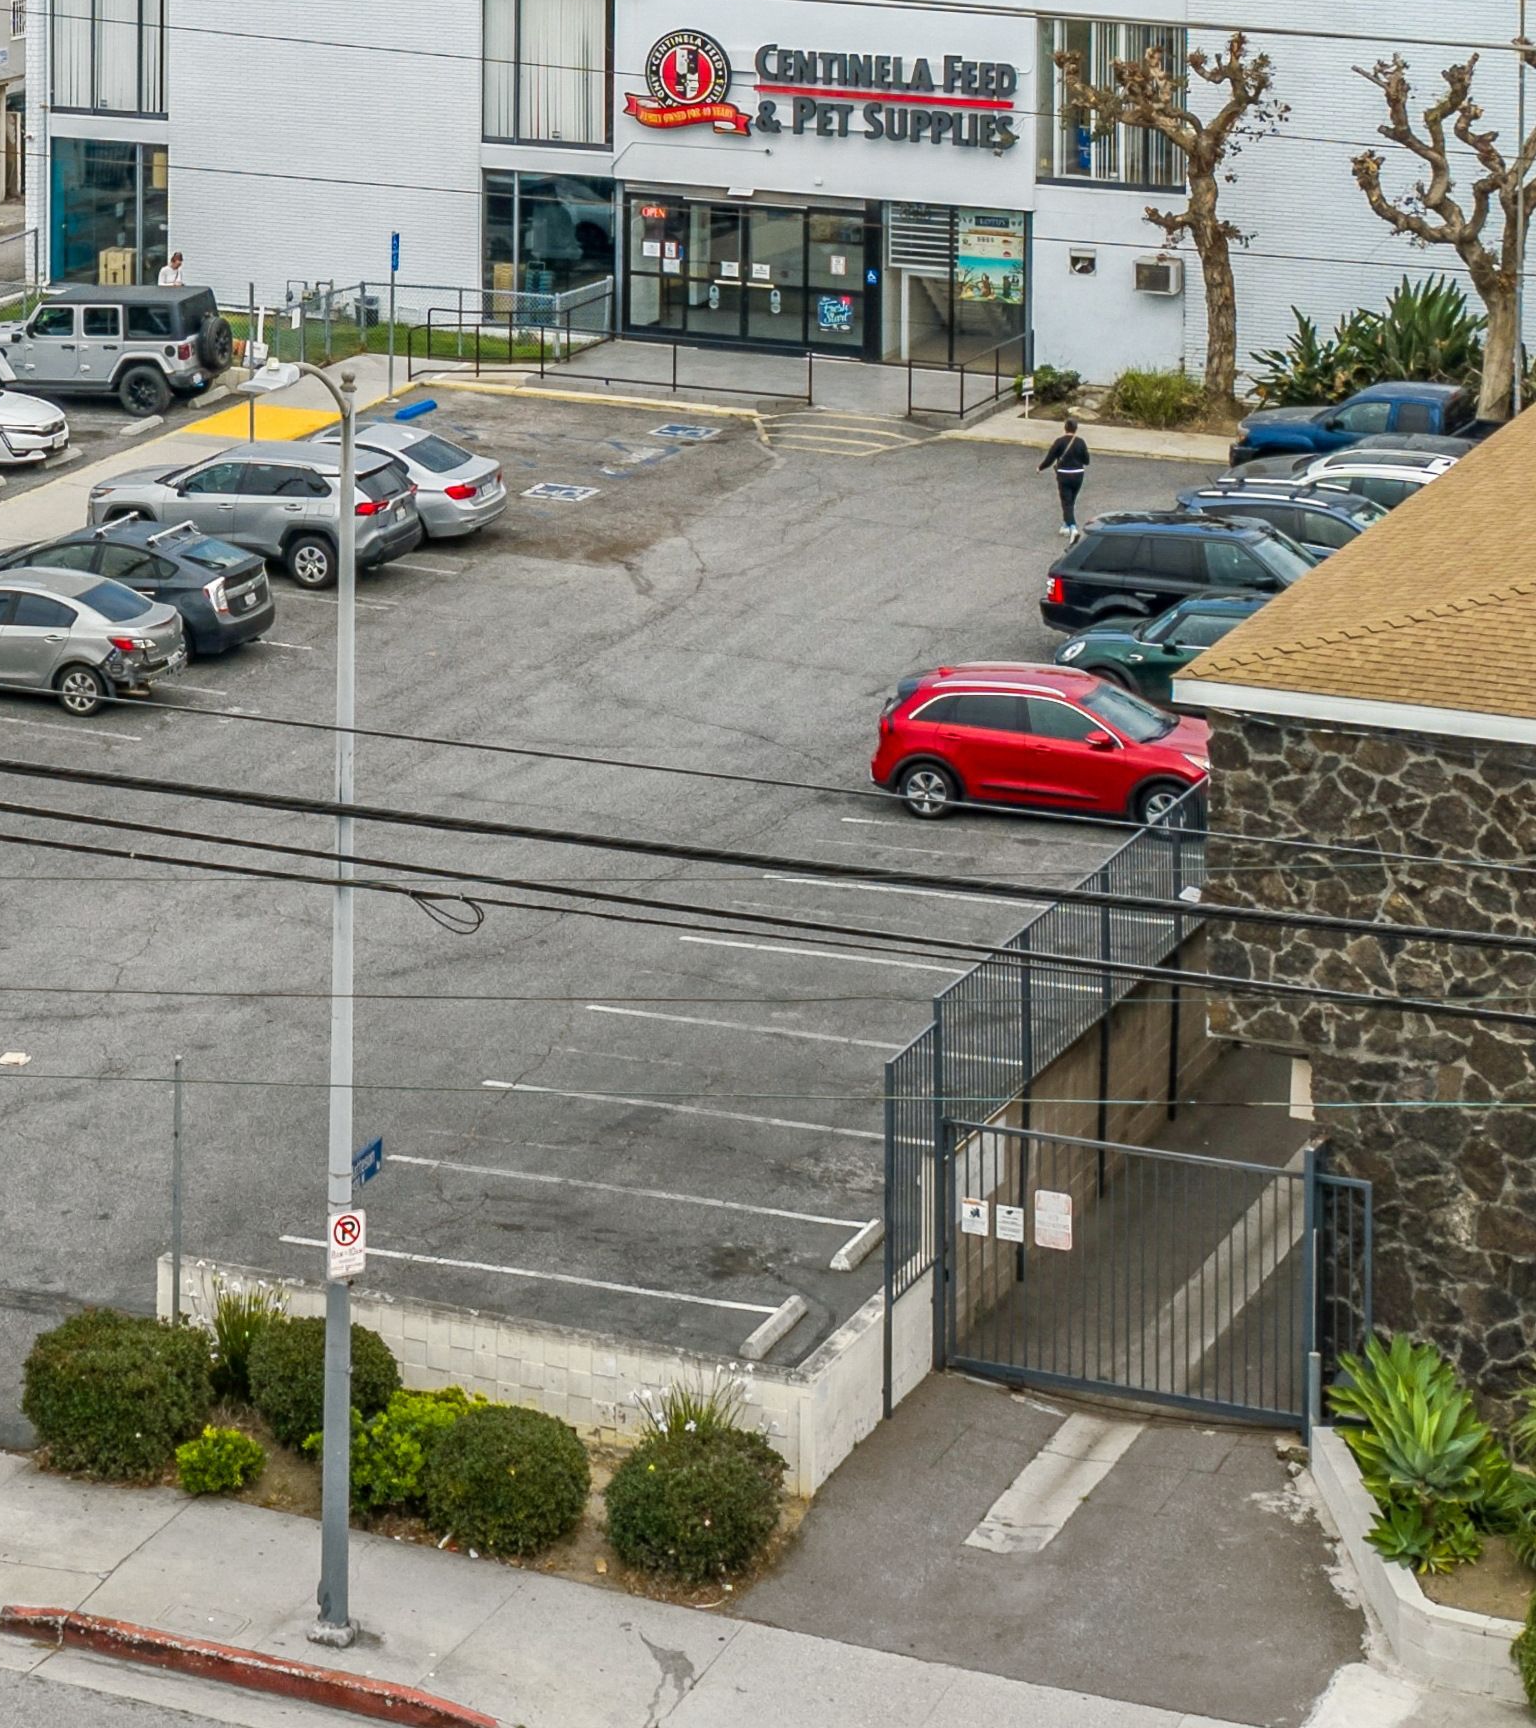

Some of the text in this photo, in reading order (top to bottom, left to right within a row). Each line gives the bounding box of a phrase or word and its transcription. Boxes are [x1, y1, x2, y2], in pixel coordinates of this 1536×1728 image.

[652, 34, 702, 65] CENTINELA
[755, 100, 782, 134] &
[792, 97, 855, 138] PET
[642, 207, 665, 218] OPEN
